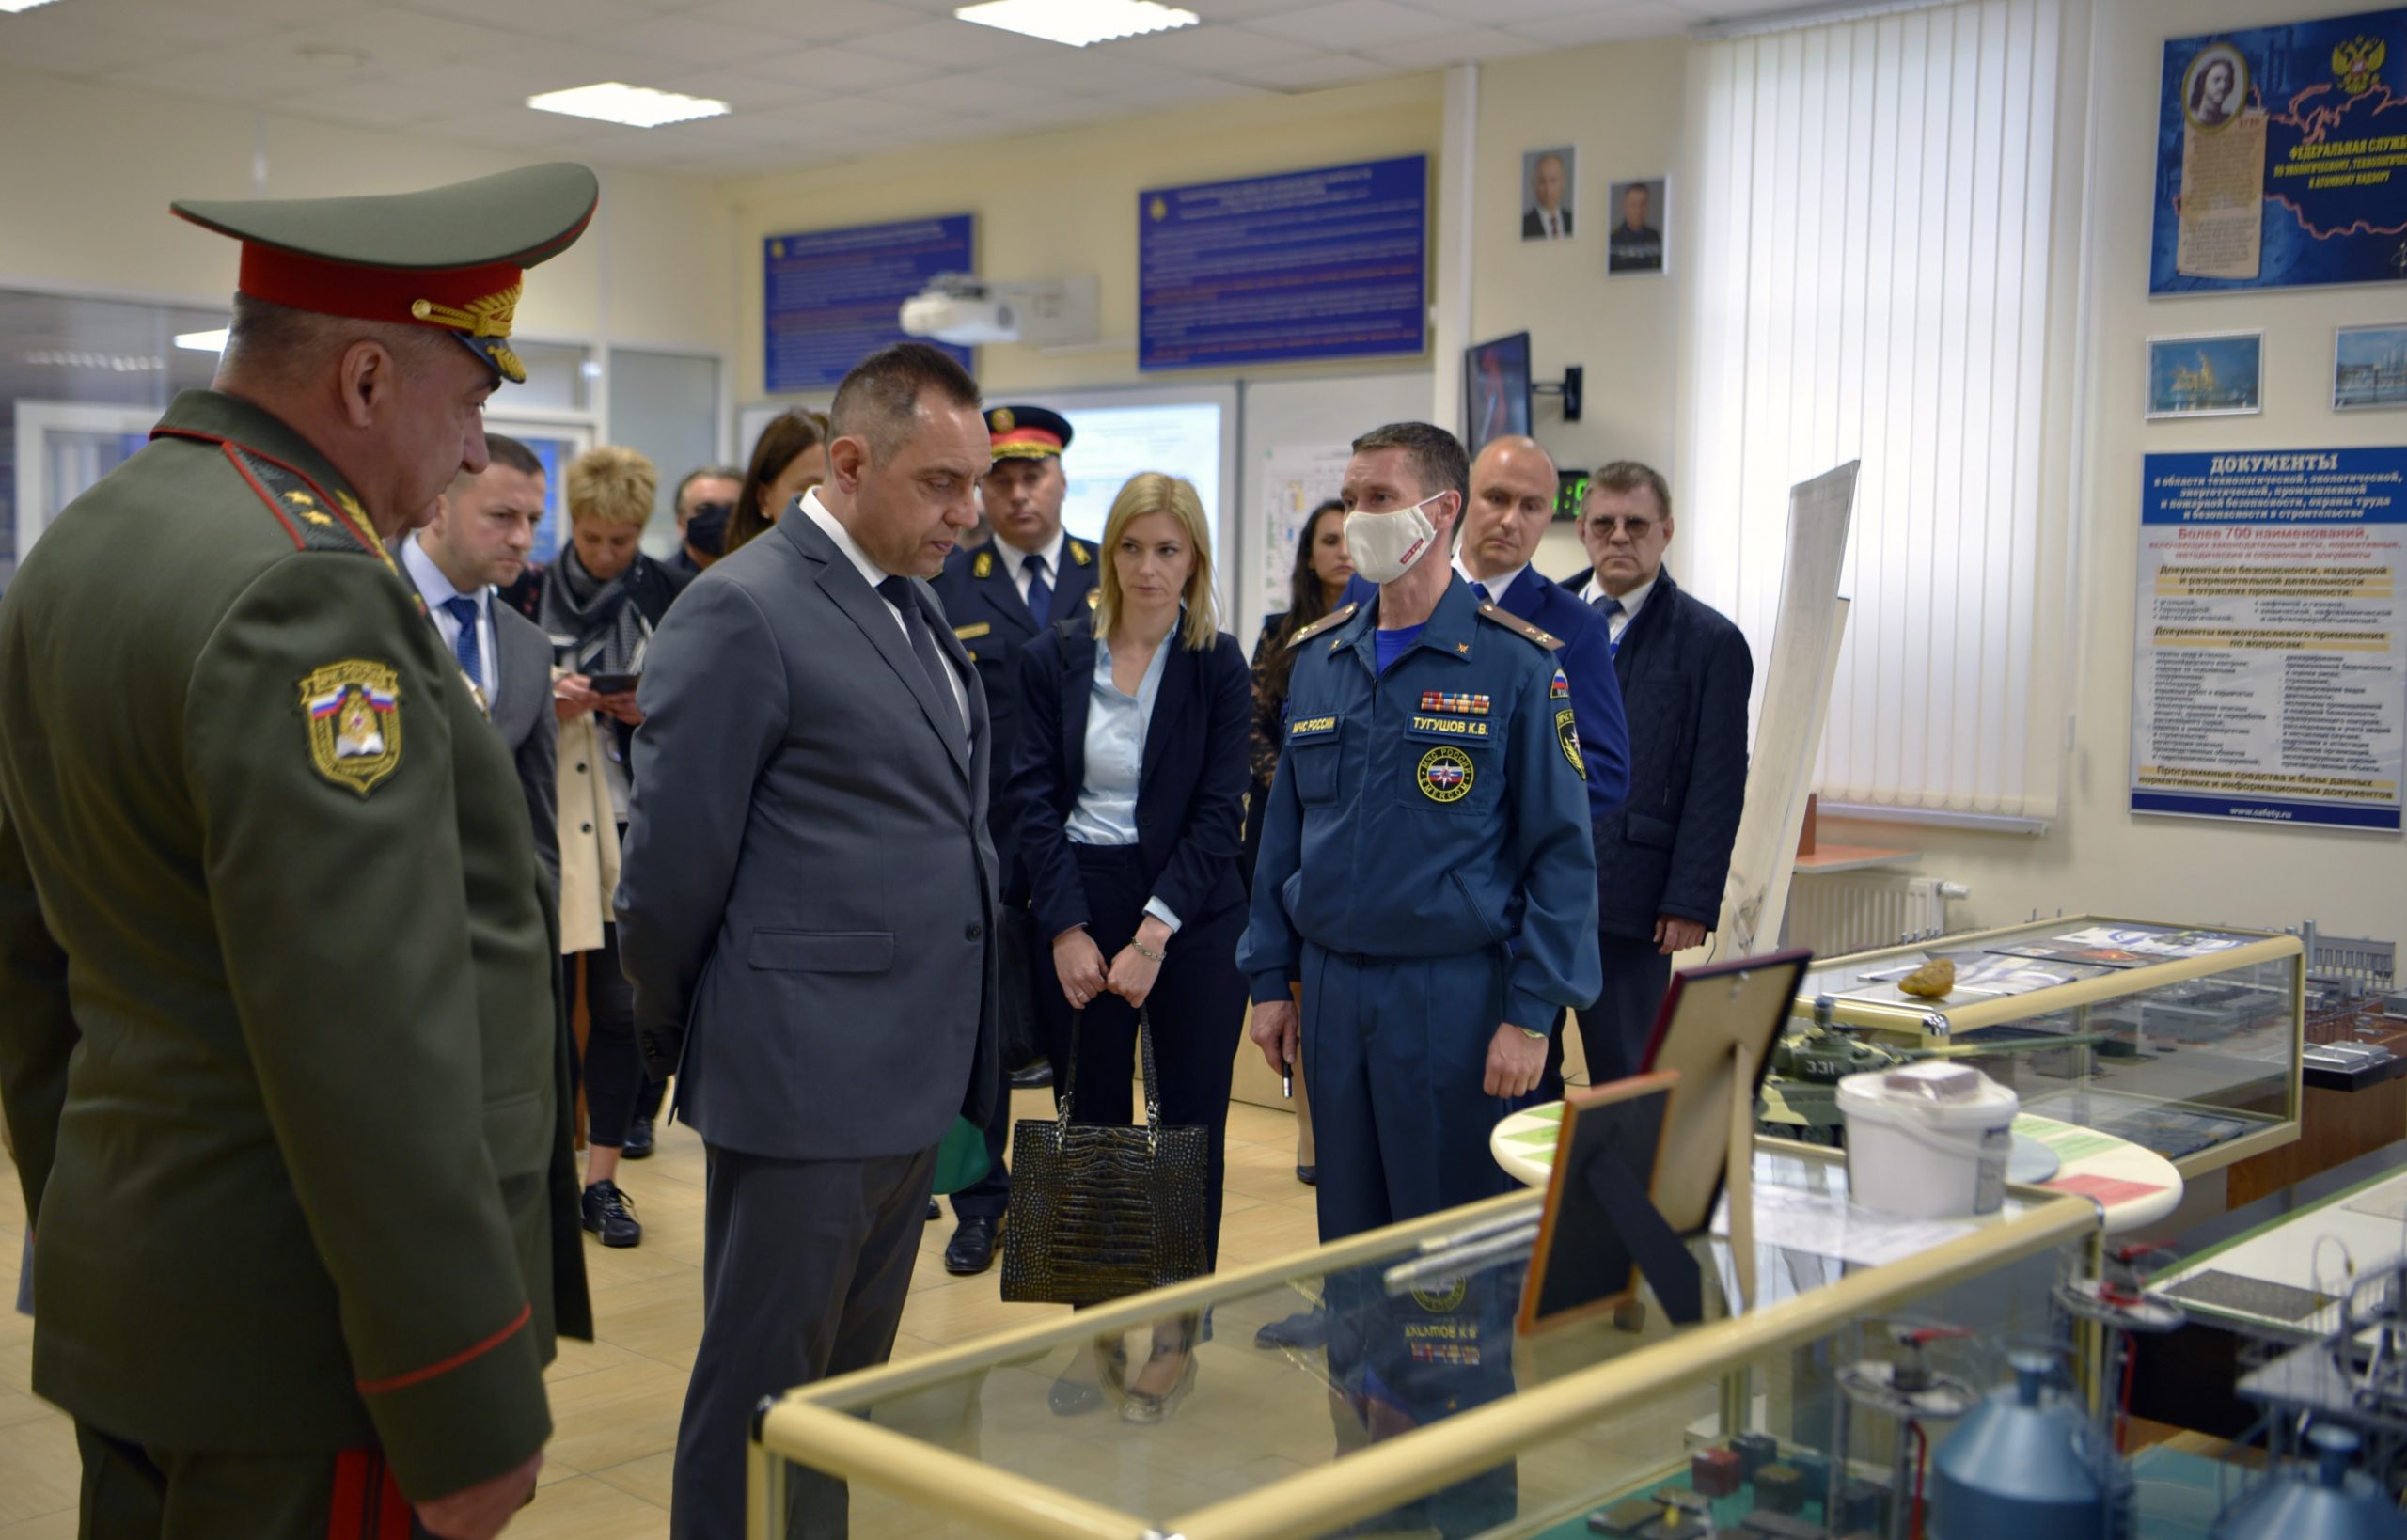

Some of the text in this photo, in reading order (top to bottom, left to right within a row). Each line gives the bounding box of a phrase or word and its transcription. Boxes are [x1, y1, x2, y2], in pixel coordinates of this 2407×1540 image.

[2289, 138, 2368, 161] ФЕДЕРАЛЬНАЯ
[2210, 453, 2338, 475] ДОКУМЕНТЫ
[2154, 471, 2403, 487] в области технологической, экологической,
[2180, 483, 2367, 499] энергетической, промышленной
[2161, 496, 2391, 511] и пожарной безопасности, охраны труда
[2183, 507, 2364, 520] и безопасности в строительстве
[2179, 526, 2369, 540] Более 700 наименований,
[2160, 564, 2220, 576] Документы
[2238, 565, 2320, 575] безопасности,
[2323, 566, 2387, 577] надзорной
[2188, 576, 2282, 587] разрешительной
[2284, 577, 2365, 588] деятельности
[2196, 588, 2246, 597] отраслях
[2248, 588, 2353, 598] промышленности:
[2154, 626, 2385, 641] Документы межотраслевого применения
[2245, 640, 2305, 650] вопросам:
[1292, 716, 1335, 734] МЧС РОССИИ
[1413, 716, 1488, 736] ТУГУШОВ К.В.
[1421, 747, 1471, 774] МЧС РОССИИ
[2156, 765, 2373, 788] Программные средства и базы данных
[1421, 778, 1469, 799] EMERCOM
[2138, 776, 2393, 800] нормативных и информационных документов
[2229, 806, 2292, 820] www.safety.ru
